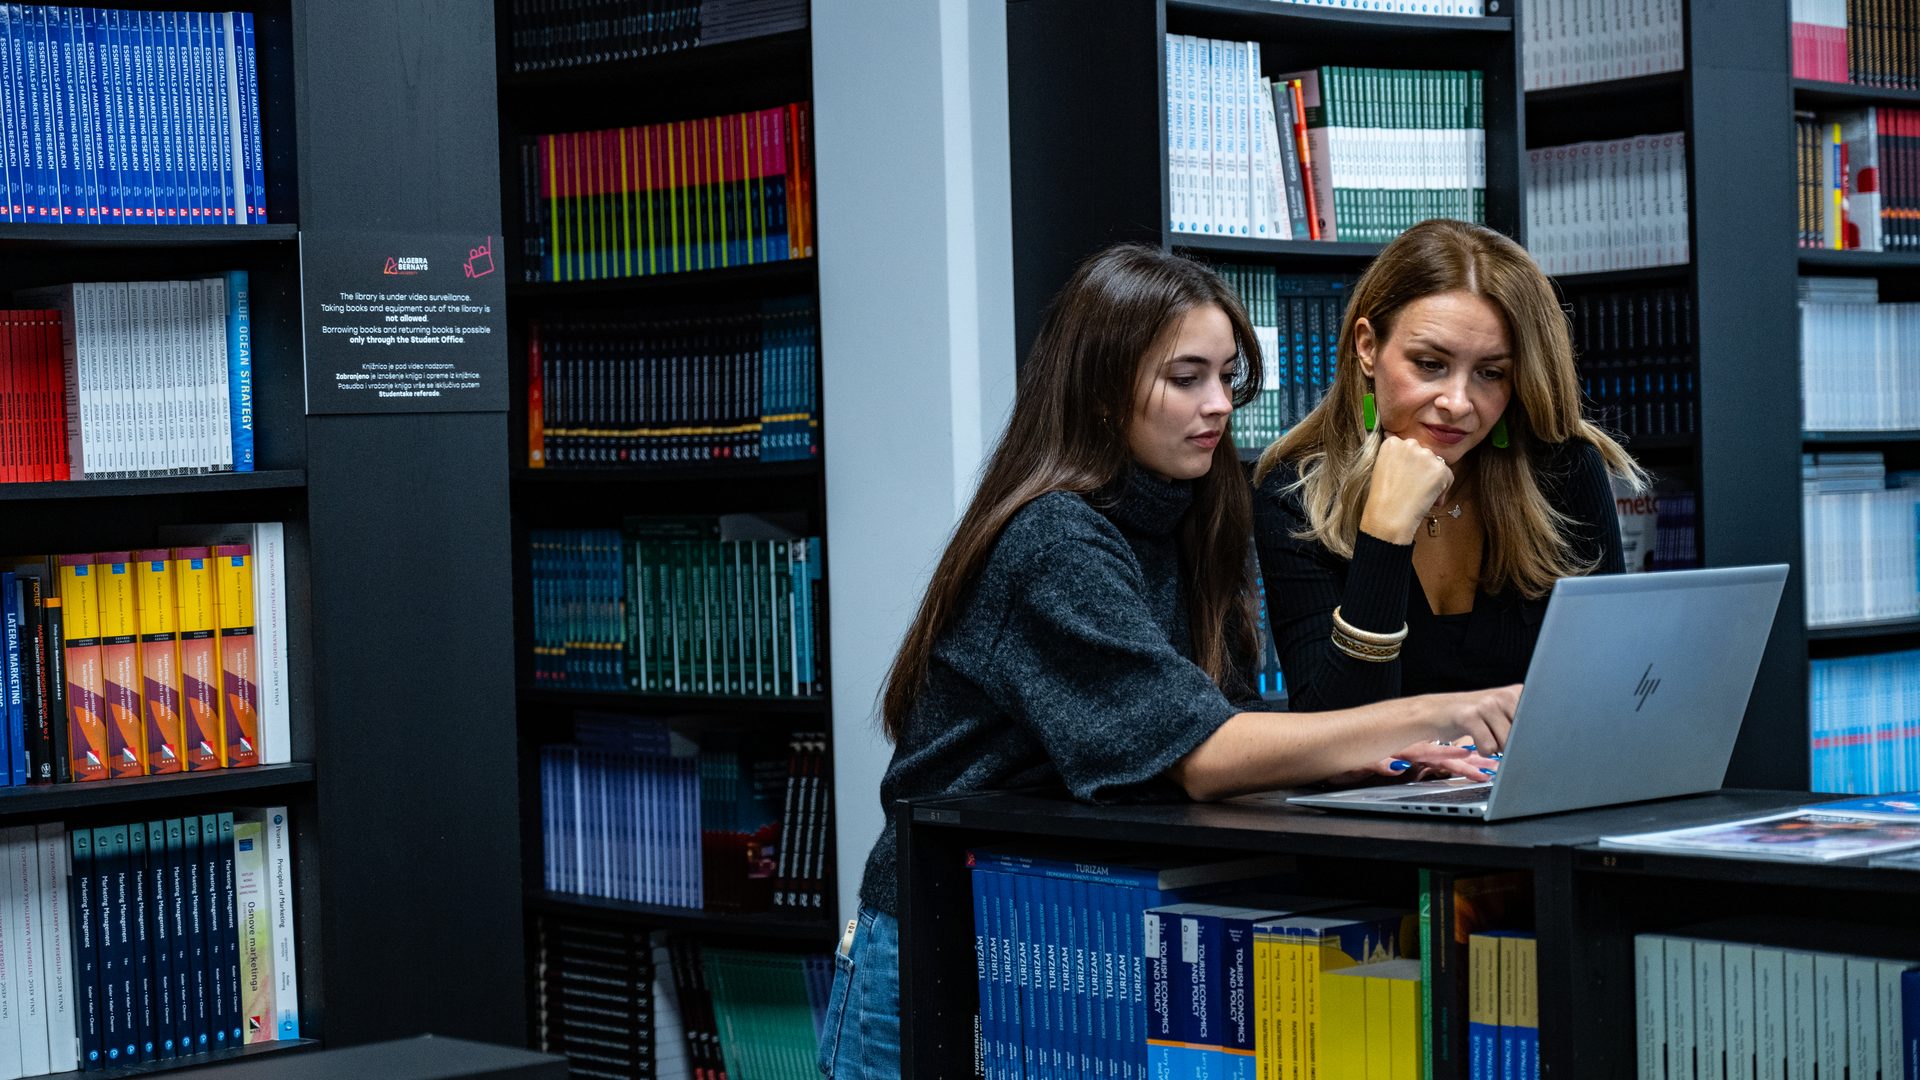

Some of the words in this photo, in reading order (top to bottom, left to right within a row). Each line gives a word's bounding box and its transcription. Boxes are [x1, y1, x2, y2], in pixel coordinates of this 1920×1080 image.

[14, 39, 23, 81] ESSENTIALS
[51, 41, 60, 82] ESSENTIALS
[100, 44, 109, 85] ESSENTIALS
[157, 46, 165, 87] ESSENTIALS
[247, 48, 257, 88] ESSENTIALS
[18, 81, 24, 90] of
[54, 83, 61, 91] of
[1176, 90, 1182, 99] OF
[1215, 94, 1222, 102] OF
[1239, 96, 1246, 104] OF
[19, 90, 27, 130] MARKETING
[55, 91, 64, 131] MARKETING
[104, 94, 113, 134] MARKETING
[161, 95, 169, 135] MARKETING
[252, 96, 260, 136] MARKETING
[1176, 103, 1184, 149] MARKETING
[22, 131, 30, 167] RESEARCH
[59, 132, 67, 168] RESEARCH
[107, 135, 116, 171] RESEARCH
[164, 135, 172, 172] RESEARCH
[255, 136, 263, 172] RESEARCH
[238, 291, 247, 321] BLUE
[320, 303, 345, 314] Taking
[346, 304, 368, 312] books
[369, 304, 384, 312] and
[385, 304, 423, 314] equipment
[424, 305, 437, 313] out
[438, 304, 446, 313] of
[447, 304, 460, 313] the
[461, 304, 483, 314] library
[484, 305, 491, 313] is
[340, 292, 354, 301] The
[355, 292, 377, 302] library
[379, 292, 385, 301] is
[386, 293, 407, 301] under
[408, 293, 428, 301] video
[429, 293, 472, 301] surveillance.
[322, 325, 358, 336] Borrowing
[360, 326, 382, 334] books
[383, 326, 397, 334] and
[398, 326, 431, 336] returning
[432, 326, 454, 334] books
[455, 326, 461, 334] is
[462, 326, 491, 336] possible
[385, 314, 399, 322] not
[400, 314, 429, 322] allowed.
[239, 326, 250, 366] OCEAN
[349, 335, 365, 346] only
[366, 335, 396, 346] through
[396, 335, 410, 344] the
[410, 335, 440, 344] Student
[335, 372, 370, 381] Zabranjeno
[240, 370, 252, 430] STRATEGY
[7, 612, 18, 651] LATERAL
[37, 624, 46, 665] MARKETING
[9, 653, 20, 705] MARKETING
[1074, 863, 1109, 876] TURIZAM
[101, 875, 109, 907] Marketing
[279, 888, 285, 897] of
[82, 908, 90, 948] Management
[102, 907, 110, 947] Management
[192, 895, 200, 934] Management
[248, 901, 256, 936] Osnove
[249, 937, 260, 992] marketinga
[976, 935, 986, 980] TURIZAM
[990, 937, 999, 982] TURIZAM
[1003, 939, 1012, 984] TURIZAM
[1019, 941, 1028, 987] TURIZAM
[1033, 943, 1042, 989] TURIZAM
[1061, 946, 1070, 993] TURIZAM
[1076, 948, 1085, 995] TURIZAM
[1105, 952, 1114, 999] TURIZAM
[1160, 940, 1168, 980] TOURISM
[1191, 962, 1199, 984] AND
[1198, 943, 1206, 983] TOURISM
[1236, 948, 1244, 987] TOURISM
[1133, 956, 1142, 1004] TURIZAM
[1229, 967, 1237, 989] AND
[1161, 980, 1169, 1034] ECONOMICS
[1192, 985, 1200, 1017] POLICY
[1199, 983, 1208, 1038] ECONOMICS
[1230, 989, 1238, 1022] POLICY
[1237, 988, 1245, 1044] ECONOMICS
